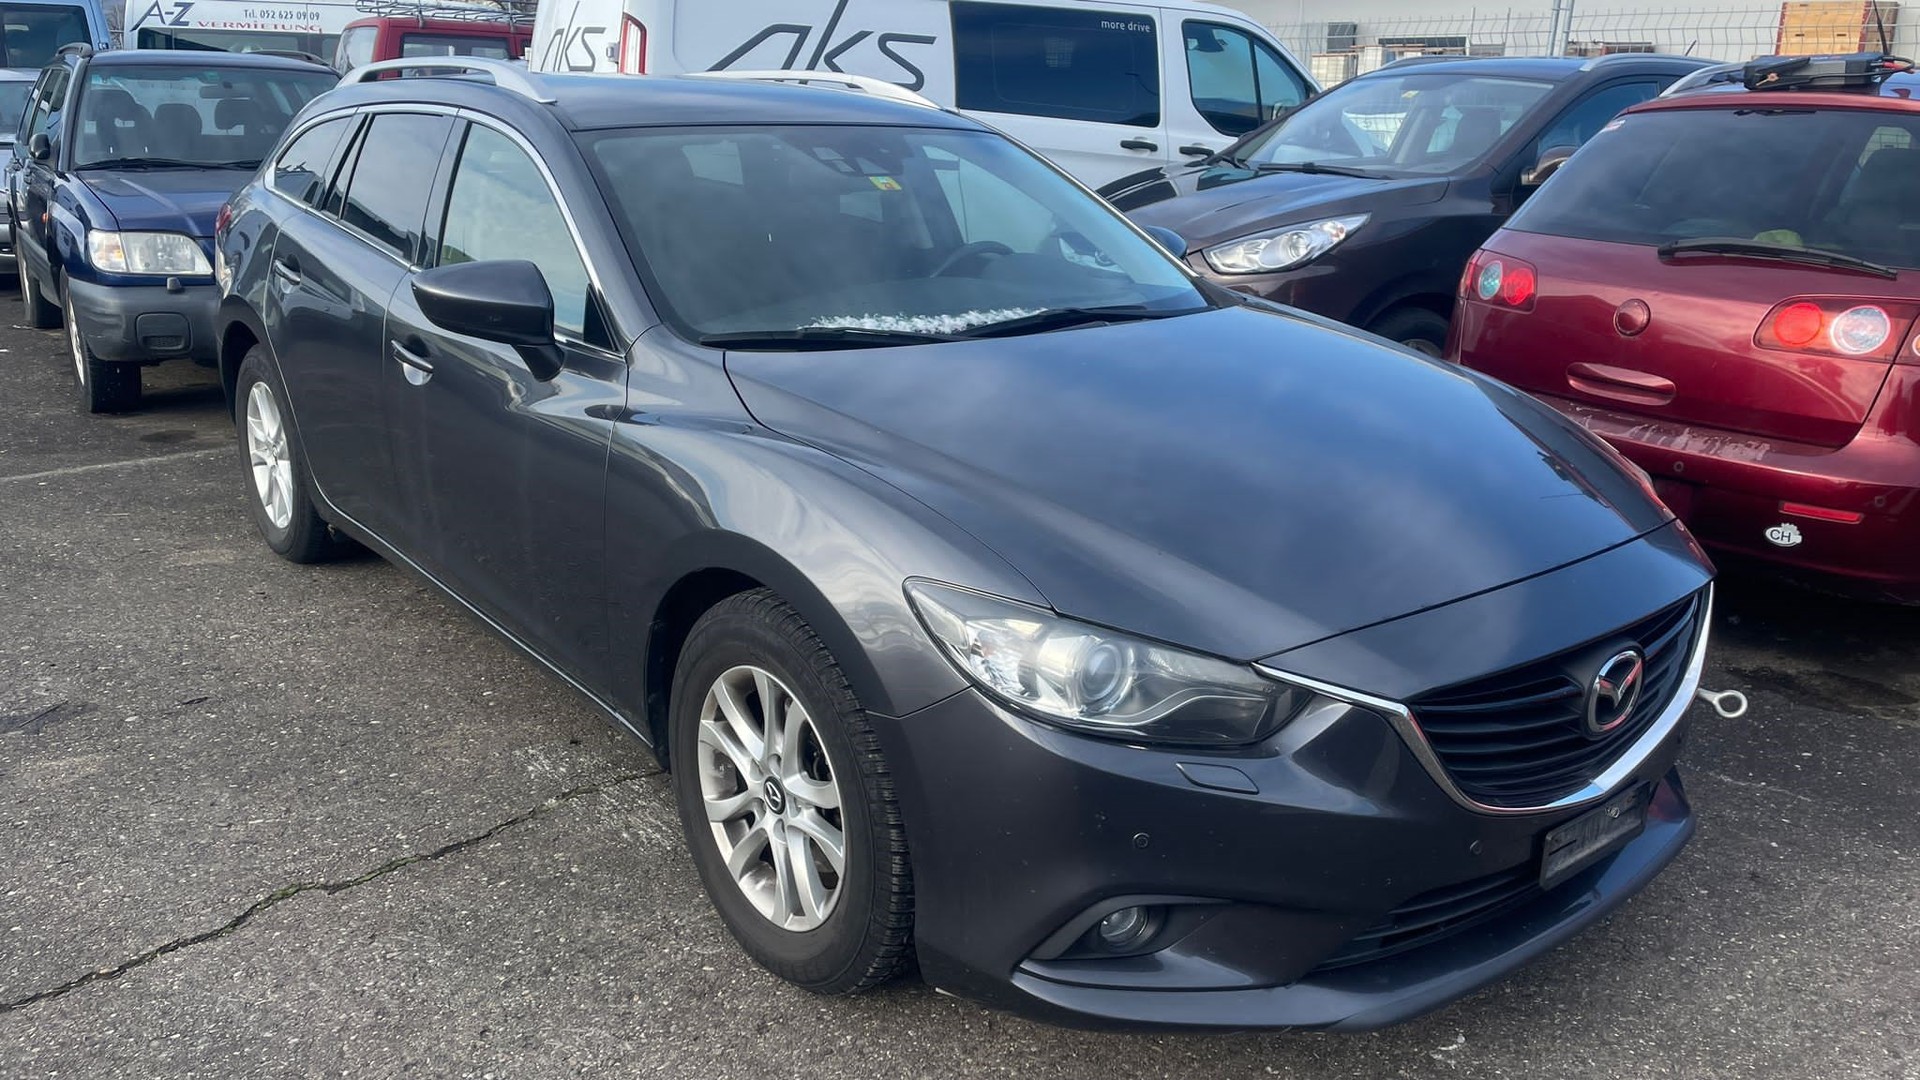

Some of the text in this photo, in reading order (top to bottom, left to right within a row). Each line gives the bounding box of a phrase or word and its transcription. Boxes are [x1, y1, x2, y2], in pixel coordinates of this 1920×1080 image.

[130, 0, 195, 32] A-Z
[259, 9, 276, 19] 052
[277, 10, 294, 20] 625
[296, 11, 308, 20] 09
[309, 11, 321, 20] 09
[1101, 20, 1151, 33] more drive
[1770, 529, 1791, 543] CH
